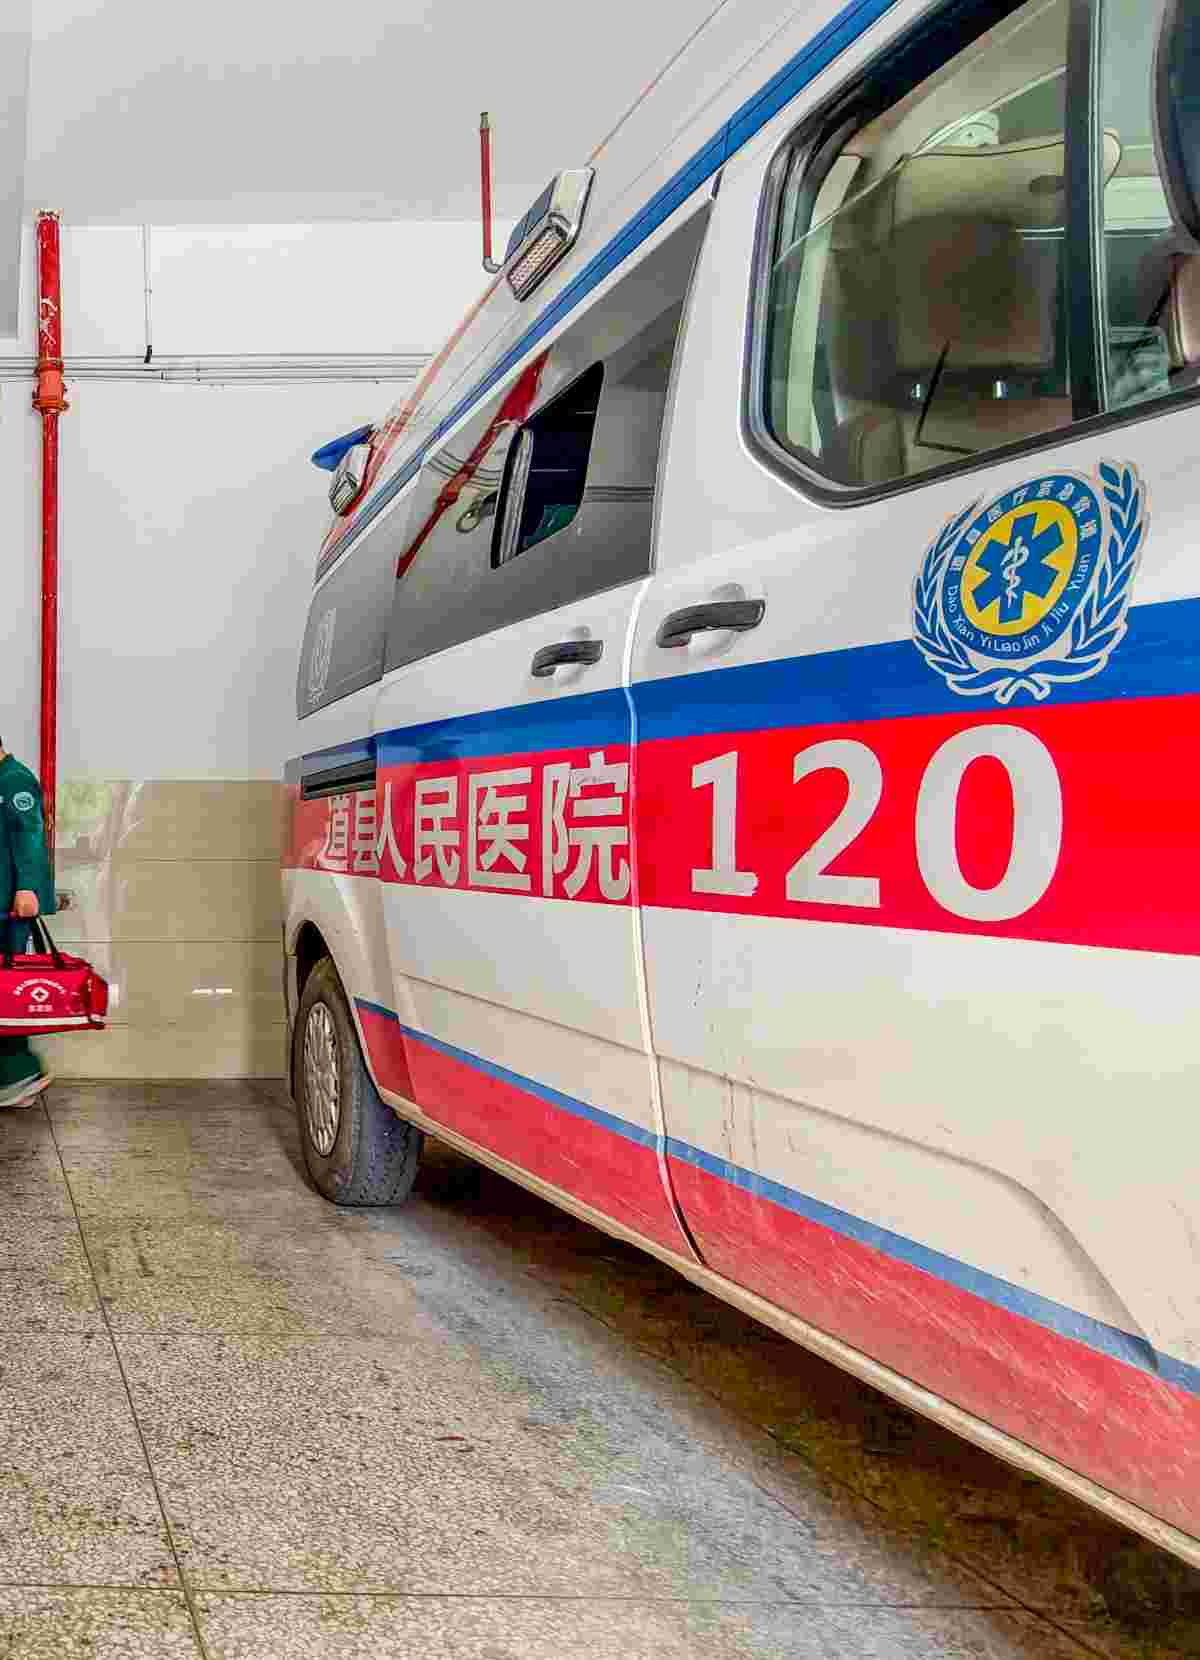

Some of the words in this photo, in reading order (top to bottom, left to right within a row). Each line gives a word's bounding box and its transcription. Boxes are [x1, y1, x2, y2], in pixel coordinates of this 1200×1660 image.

[315, 751, 631, 900] 道县人民医院
[689, 724, 1063, 922] 120
